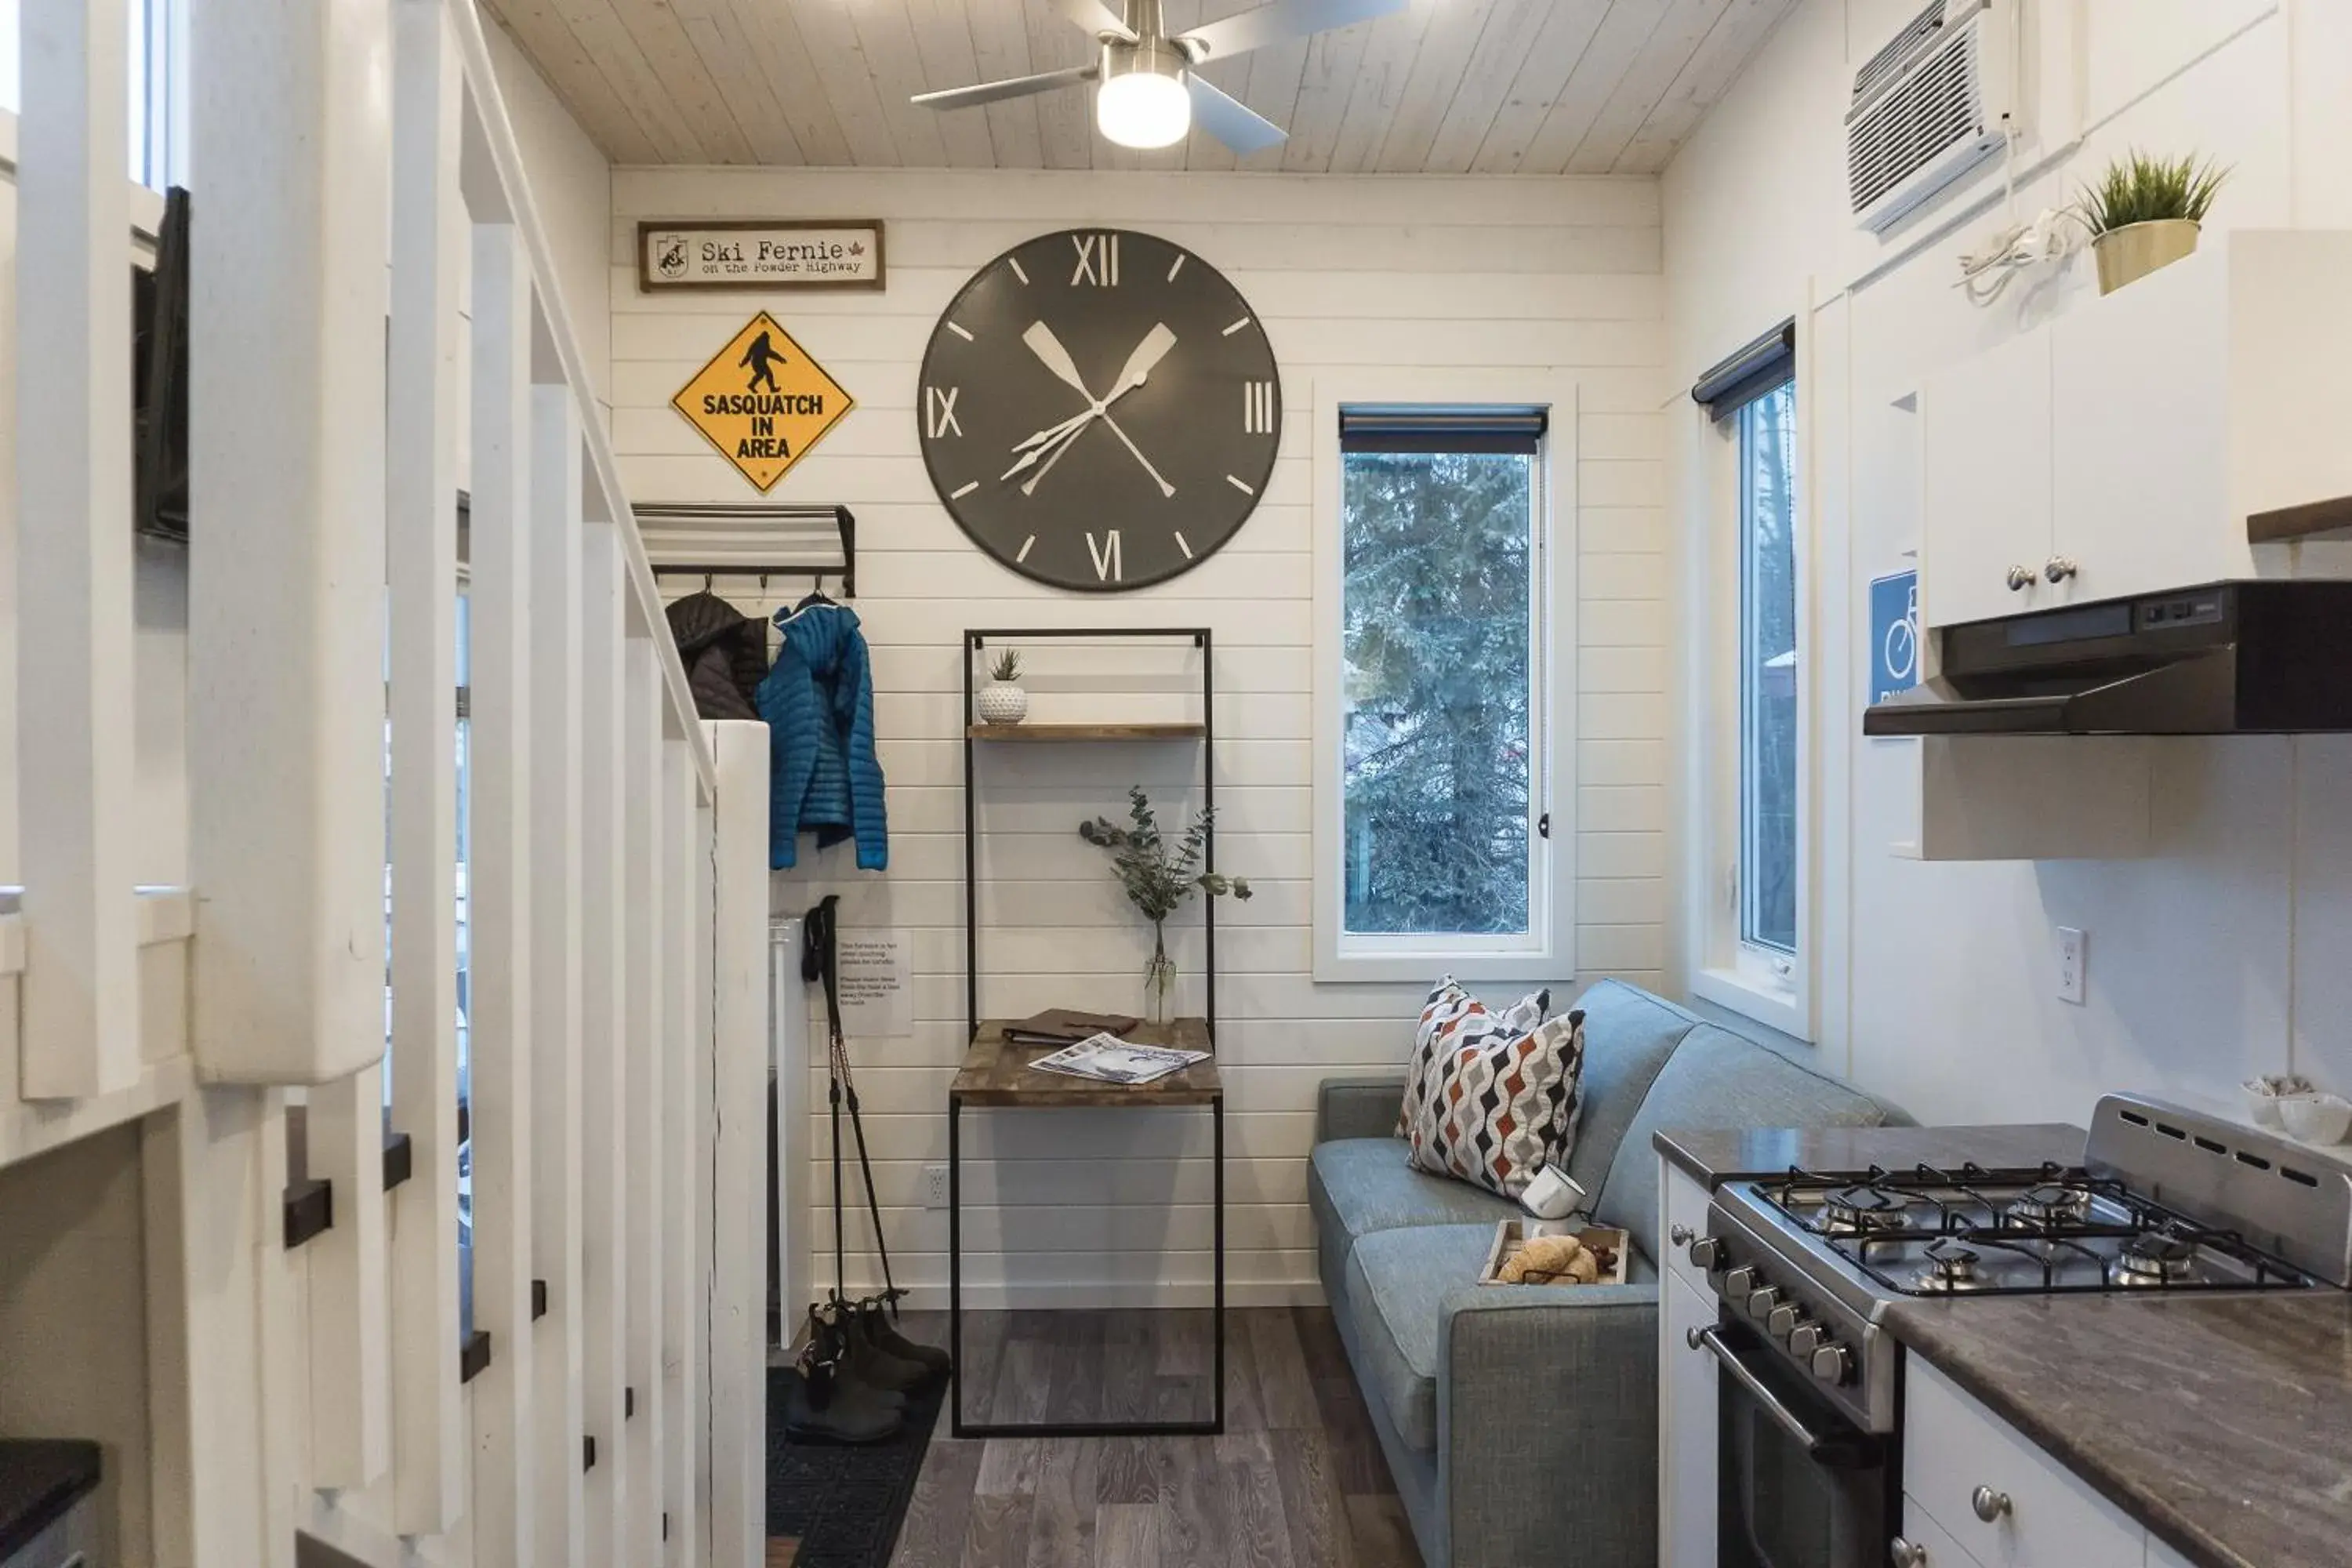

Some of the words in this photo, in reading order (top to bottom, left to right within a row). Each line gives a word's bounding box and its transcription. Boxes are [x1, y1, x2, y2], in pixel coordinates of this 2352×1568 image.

[702, 241, 744, 262] Ski
[757, 241, 843, 261] Fernie
[1071, 234, 1119, 286] XII
[702, 265, 718, 274] on
[725, 263, 748, 274] the
[754, 263, 799, 273] Powder
[806, 262, 861, 274] Highway
[703, 395, 823, 415] SASQUATCH
[926, 387, 963, 439] IX
[1245, 382, 1272, 434] III
[752, 419, 774, 436] IN
[737, 439, 791, 458] AREA
[1085, 530, 1122, 582] VI
